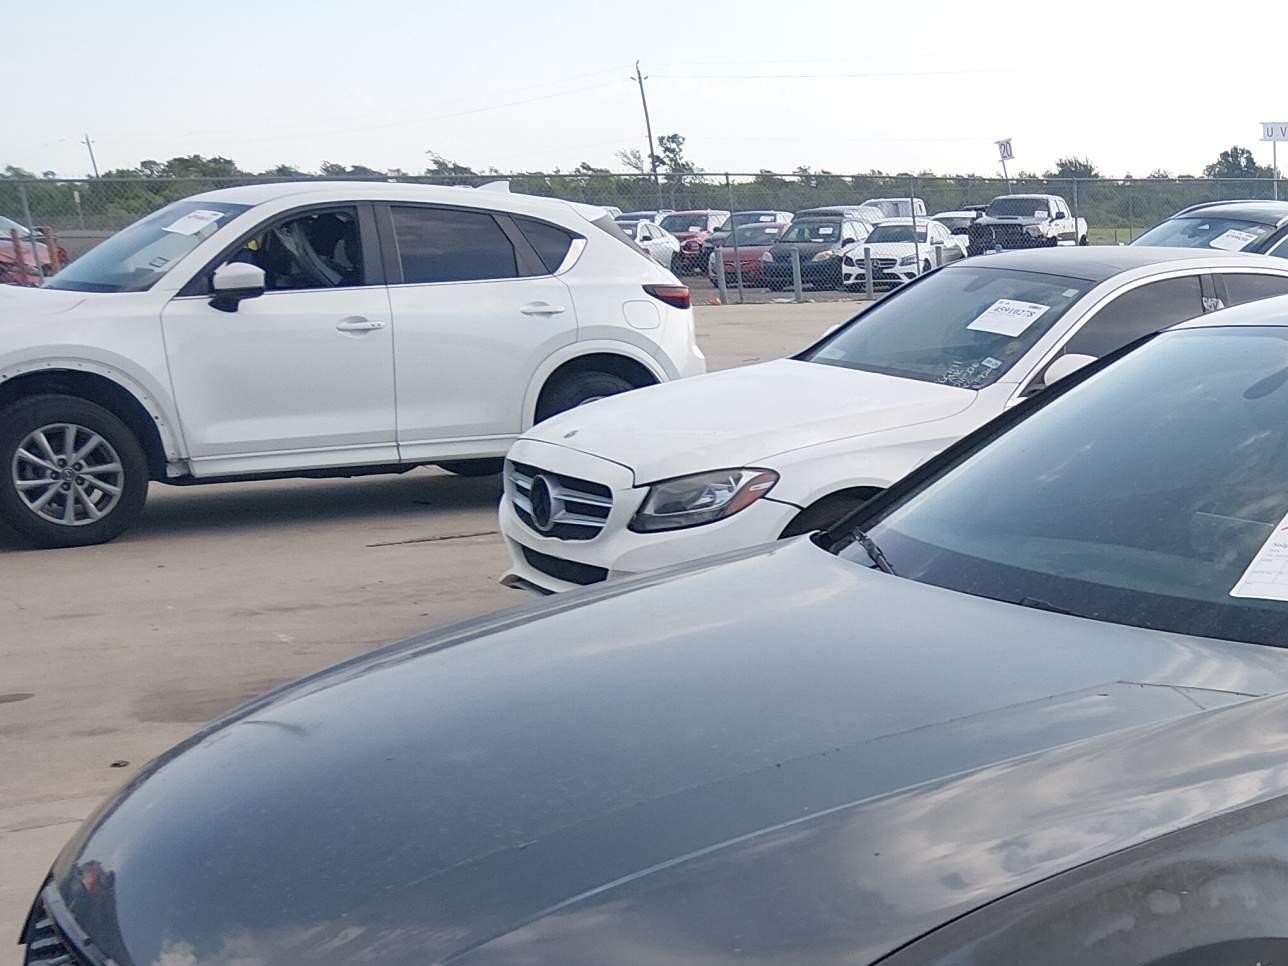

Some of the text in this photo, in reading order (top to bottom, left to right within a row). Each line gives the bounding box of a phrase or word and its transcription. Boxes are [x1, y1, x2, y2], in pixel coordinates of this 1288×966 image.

[1266, 126, 1287, 138] U V
[999, 143, 1012, 159] 20
